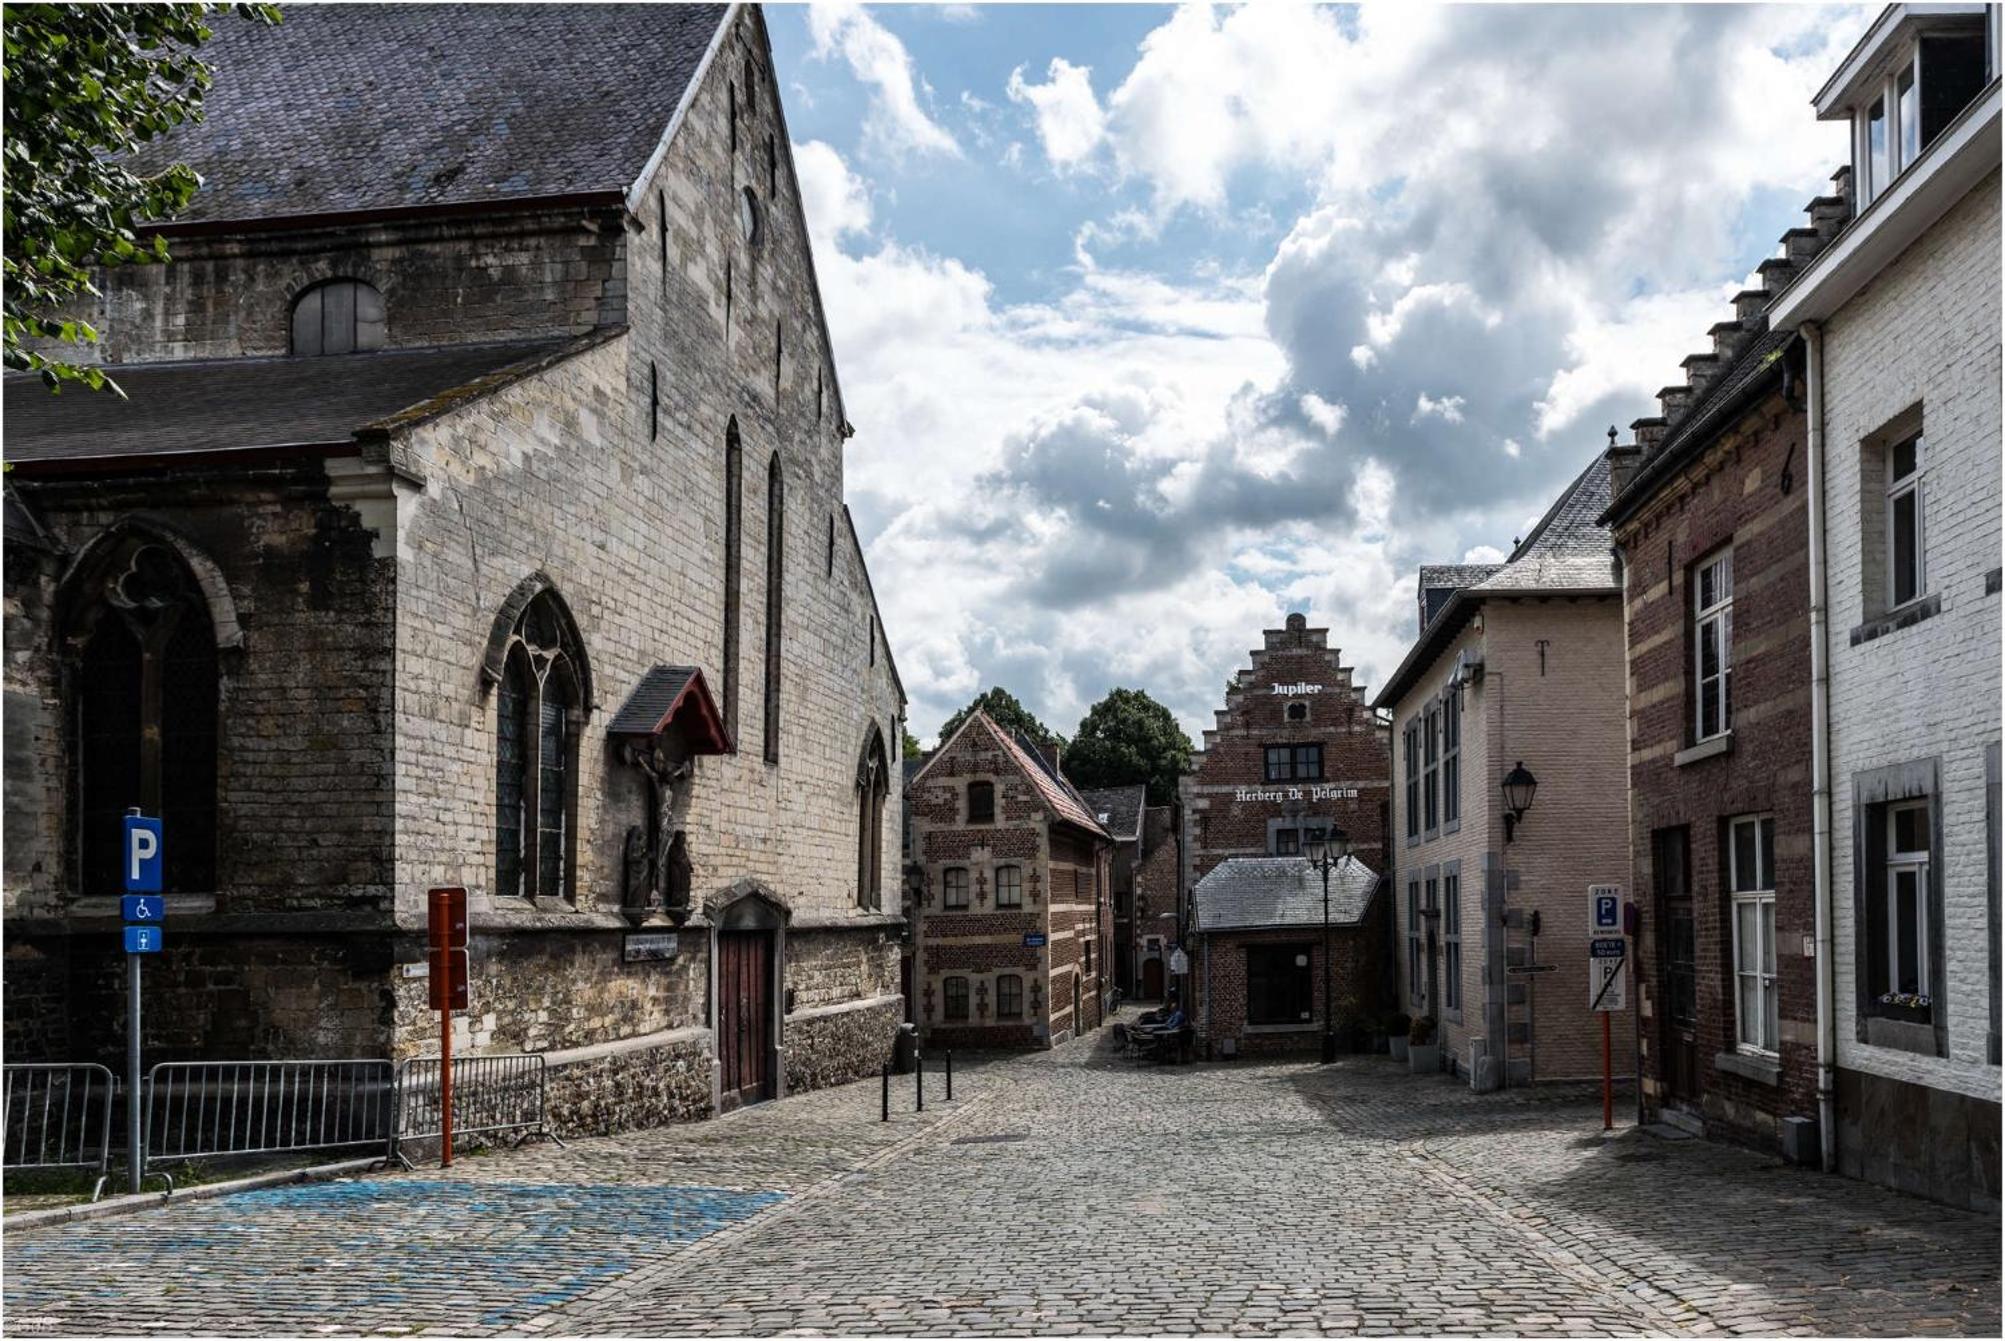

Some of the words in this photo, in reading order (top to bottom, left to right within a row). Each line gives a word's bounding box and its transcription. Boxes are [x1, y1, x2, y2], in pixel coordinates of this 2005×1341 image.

[1271, 681, 1323, 697] Jupiler
[1235, 789, 1283, 803] Herberg
[1288, 788, 1304, 800] De
[1312, 786, 1358, 803] Pelgrim
[131, 828, 157, 880] P
[1594, 888, 1619, 896] ZONE
[1601, 899, 1612, 915] P
[1604, 966, 1612, 980] P
